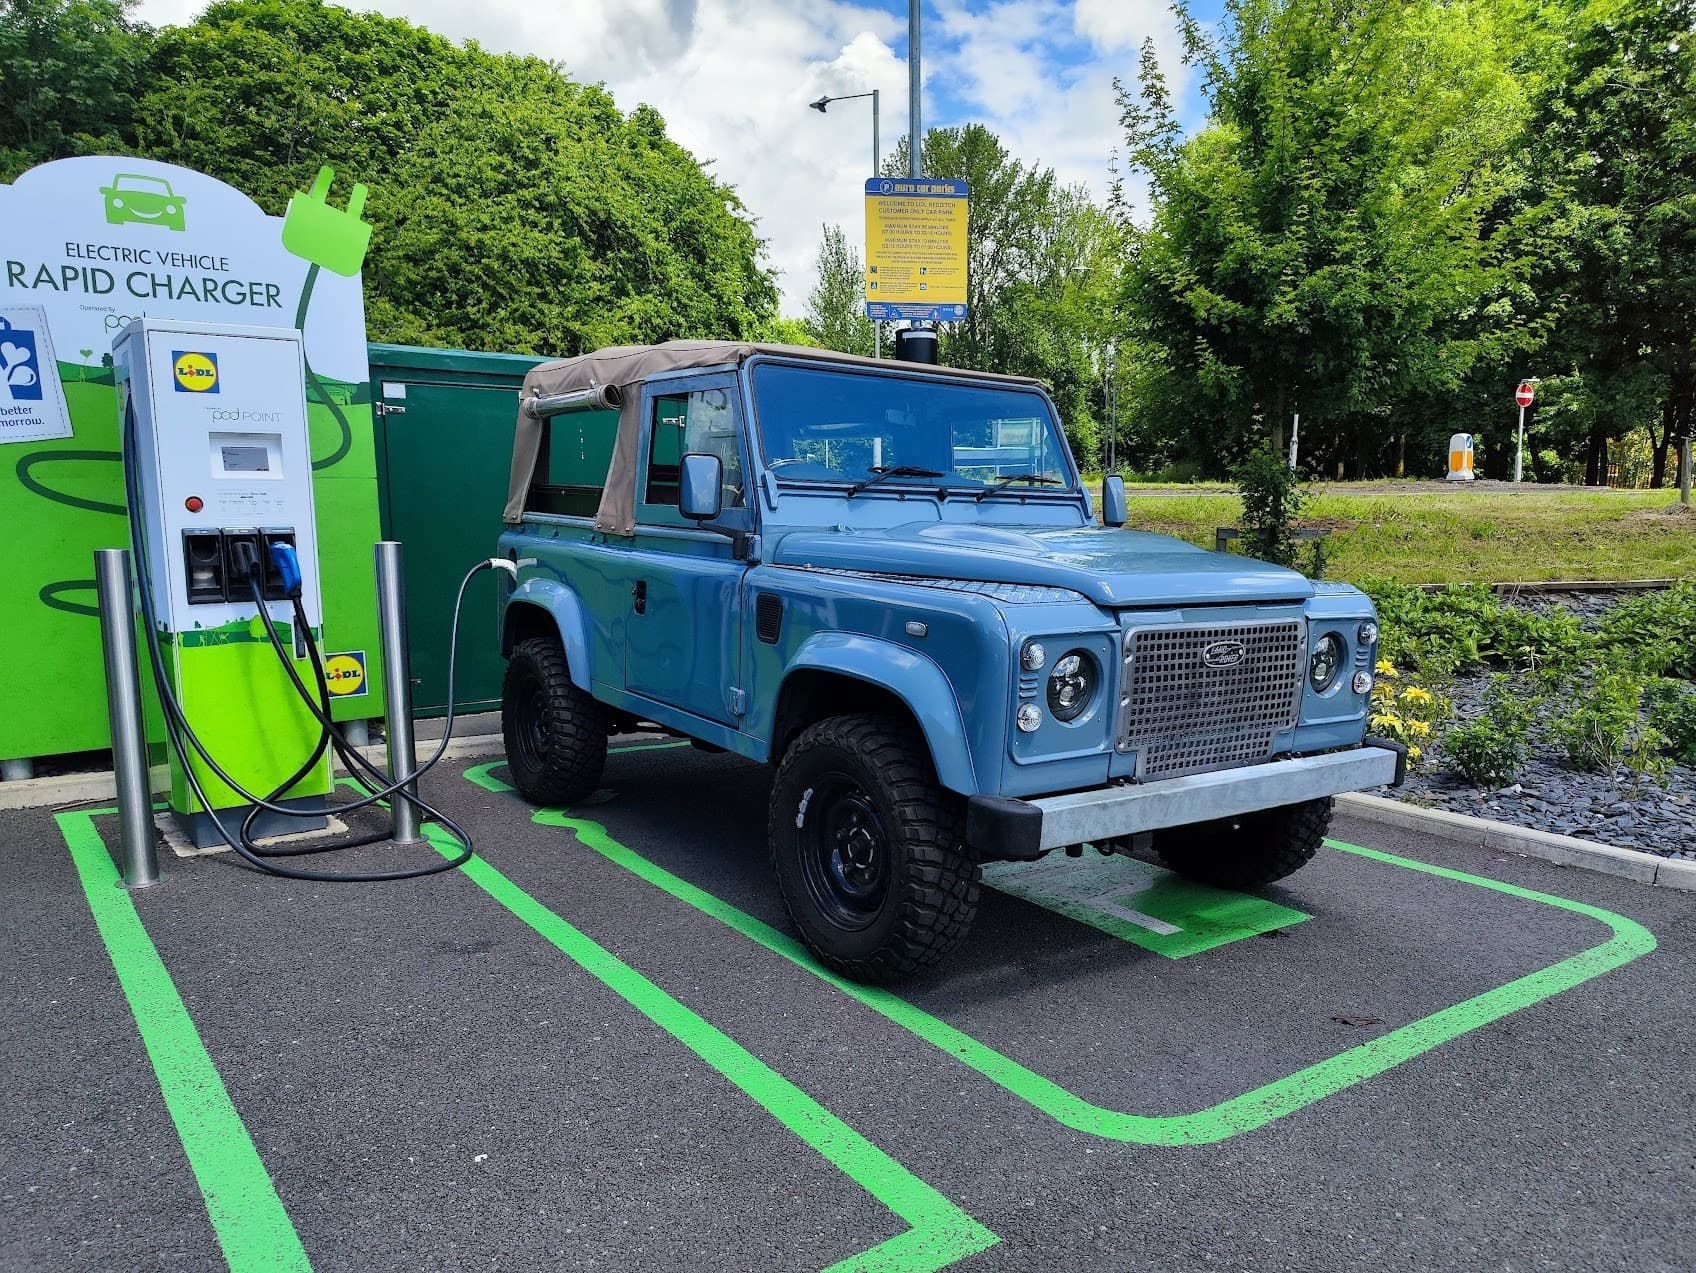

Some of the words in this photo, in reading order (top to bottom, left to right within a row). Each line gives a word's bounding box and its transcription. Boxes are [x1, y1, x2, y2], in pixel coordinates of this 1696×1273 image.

[928, 201, 956, 209] REDDITCH
[65, 242, 152, 265] ELECTRIC
[156, 250, 230, 272] VEHICLE
[6, 260, 115, 295] RAPID
[126, 271, 283, 309] CHARGER
[79, 304, 107, 312] Operated
[0, 405, 33, 416] better
[212, 408, 240, 423] pod
[242, 411, 281, 423] POINT
